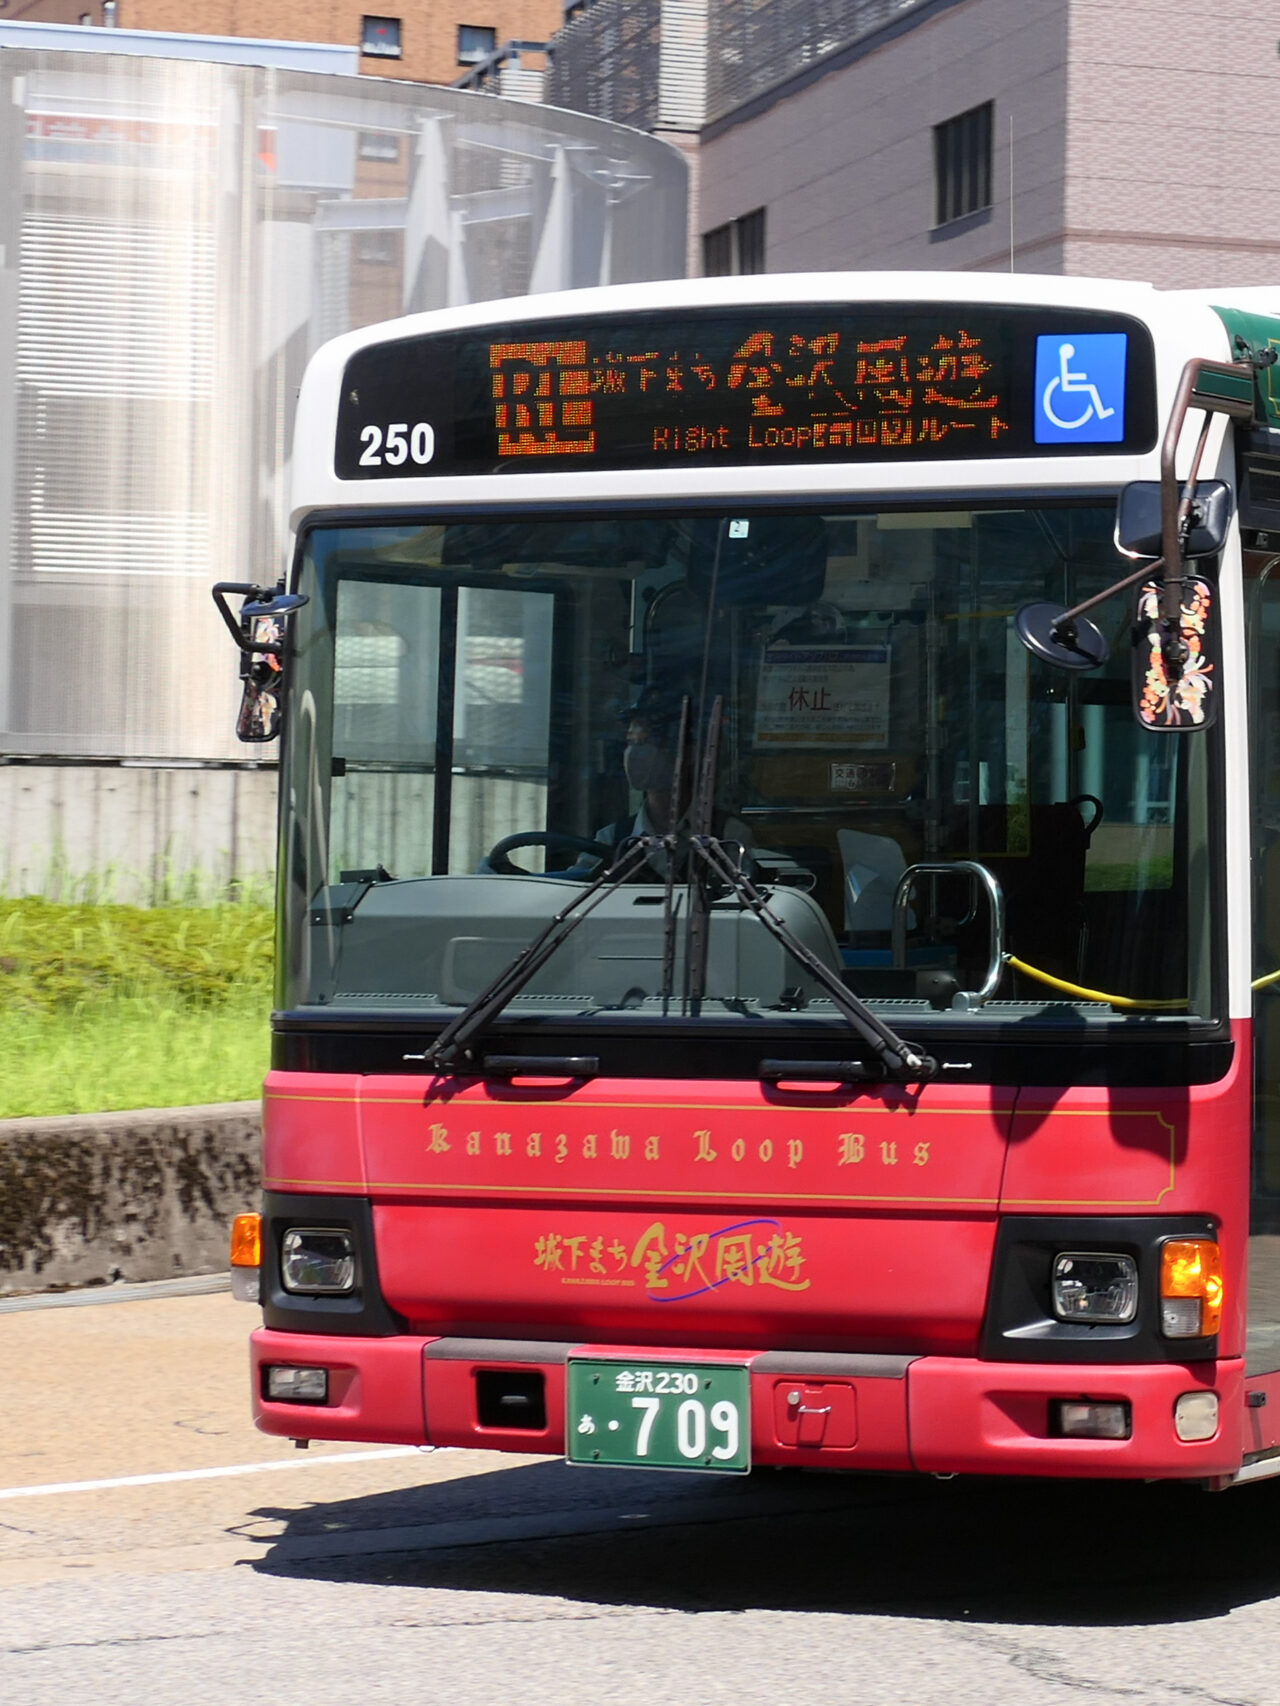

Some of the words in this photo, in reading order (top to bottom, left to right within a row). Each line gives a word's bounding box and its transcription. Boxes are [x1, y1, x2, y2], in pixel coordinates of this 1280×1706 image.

[359, 422, 435, 466] 250
[653, 425, 730, 452] Right
[788, 686, 833, 712] 休止
[426, 1122, 661, 1164] Kanazawa
[693, 1129, 804, 1169] Loop
[837, 1132, 931, 1167] Bus
[533, 1222, 811, 1292] 城下まち金沢周遊
[577, 1413, 596, 1435] あ
